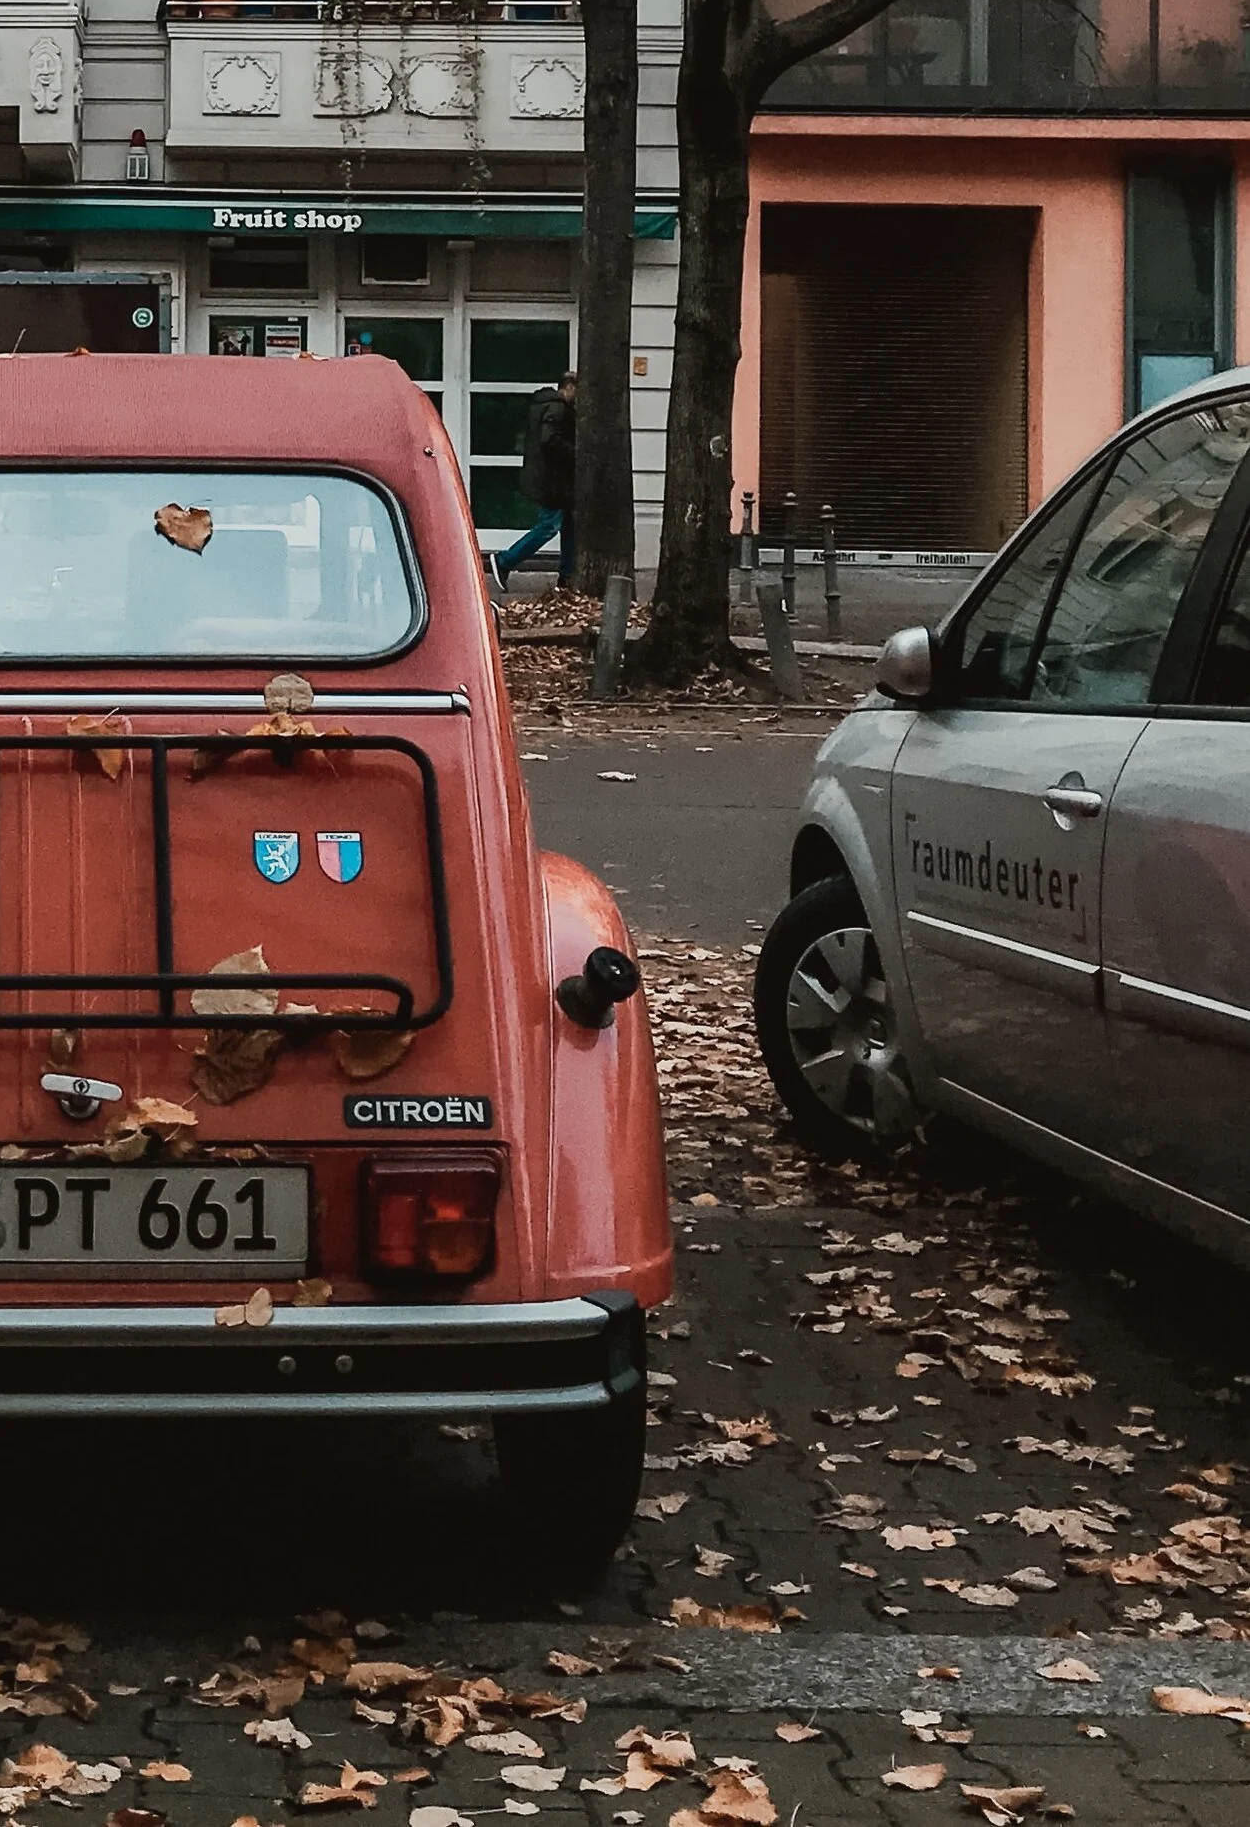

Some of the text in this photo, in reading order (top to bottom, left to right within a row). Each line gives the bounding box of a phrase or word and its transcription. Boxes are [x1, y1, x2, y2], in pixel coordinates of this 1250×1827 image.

[213, 208, 362, 233] Fruit shop
[916, 553, 970, 564] freihalten!
[912, 839, 1079, 911] raumdeuter
[353, 1097, 485, 1123] CITROËN
[13, 1176, 111, 1251] PT
[138, 1177, 277, 1251] 661
